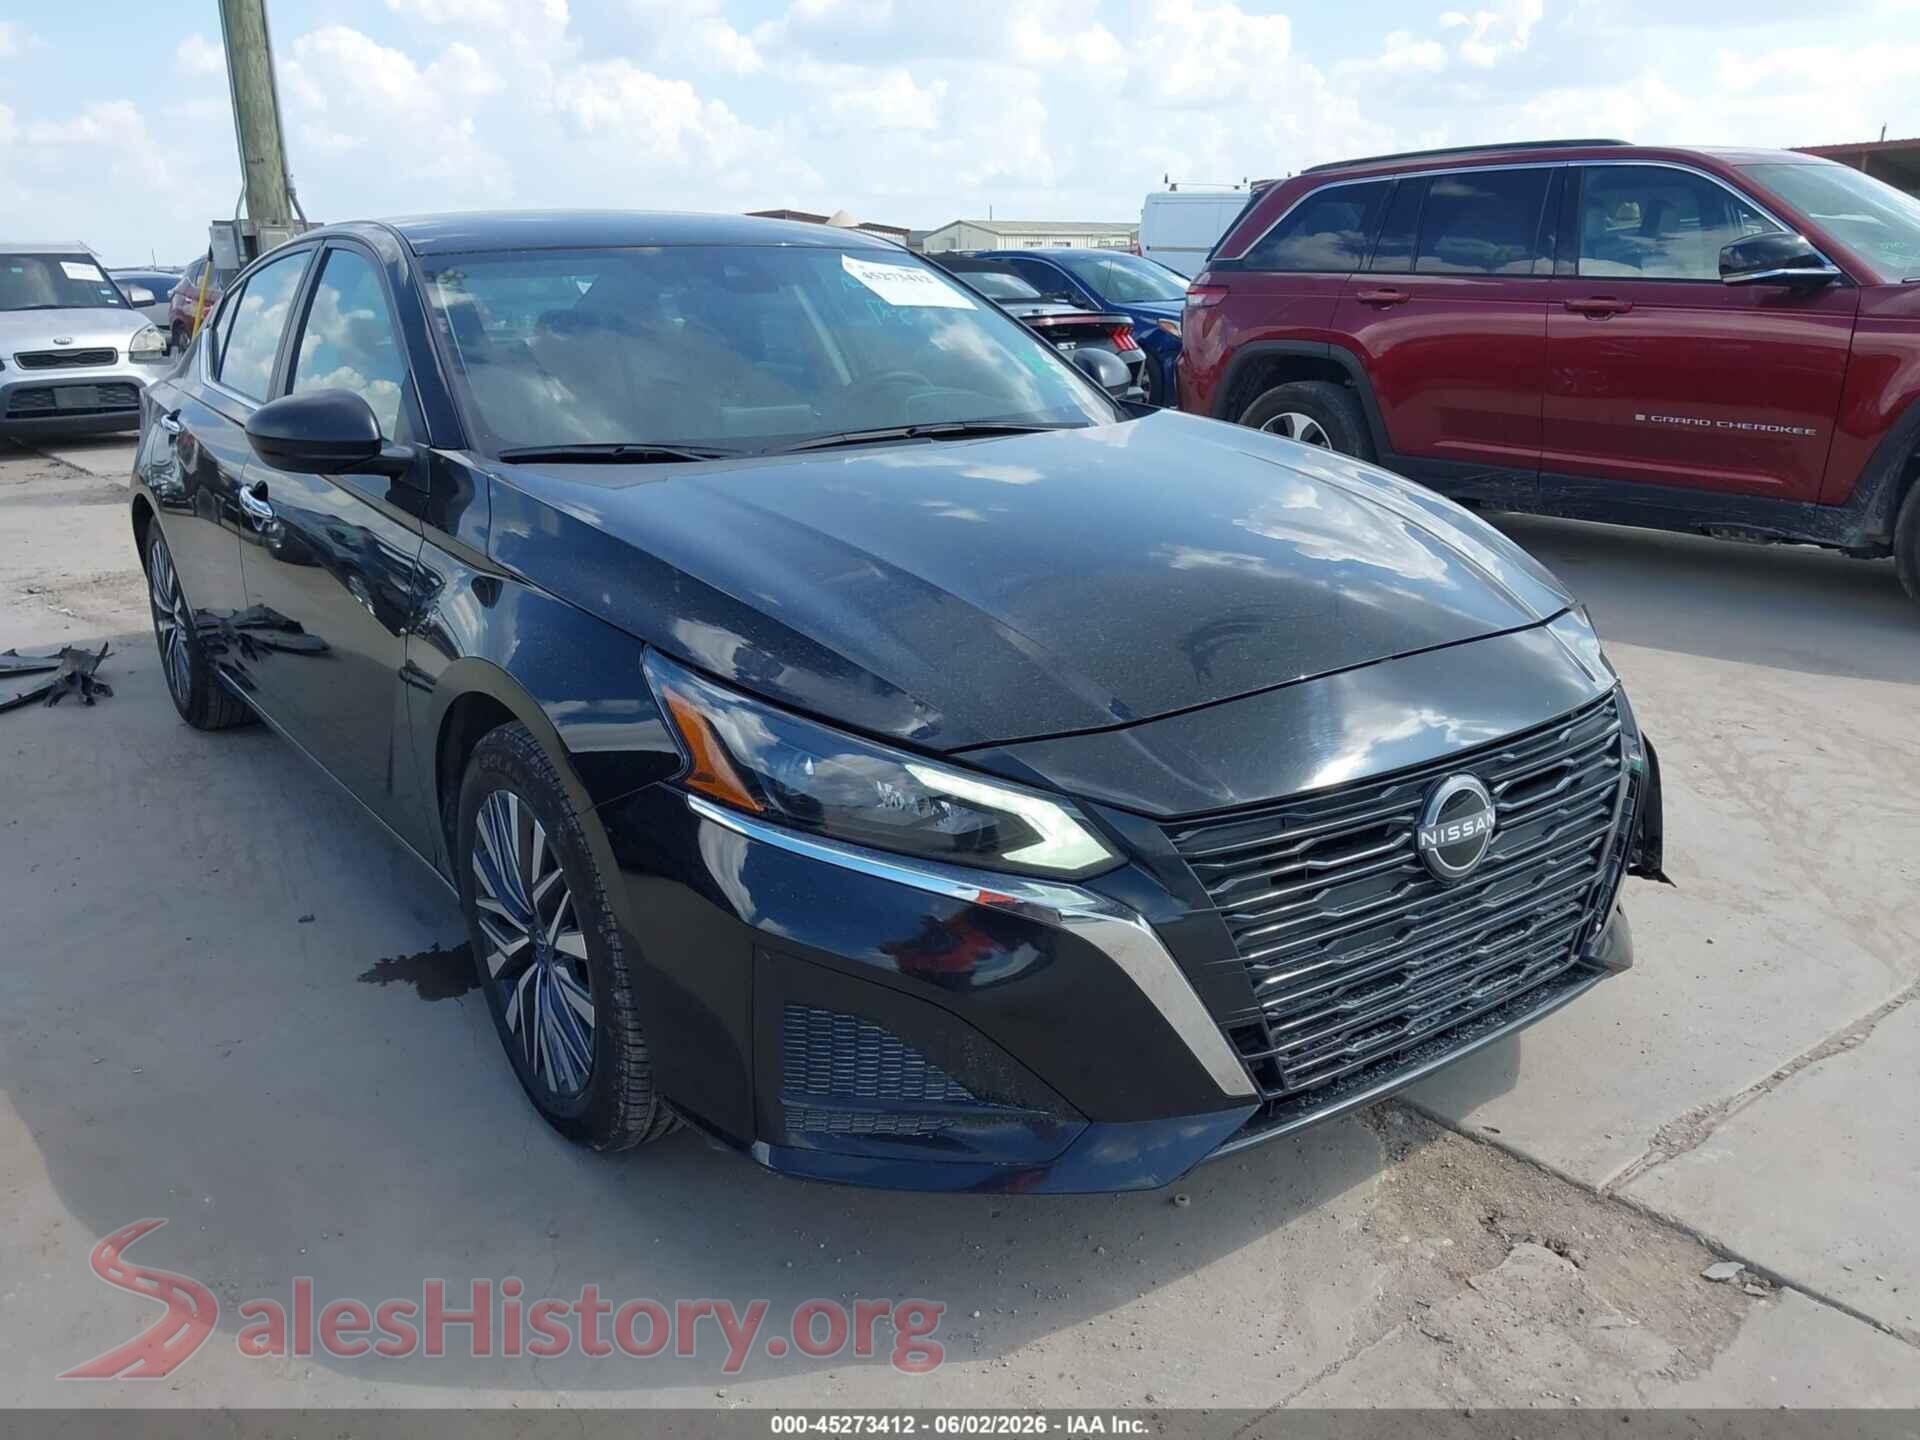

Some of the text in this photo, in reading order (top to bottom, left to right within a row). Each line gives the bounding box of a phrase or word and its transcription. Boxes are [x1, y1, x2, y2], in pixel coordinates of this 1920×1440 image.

[1650, 414, 1817, 436] GRAND CHEROKEE
[1420, 812, 1496, 846] NISSAN
